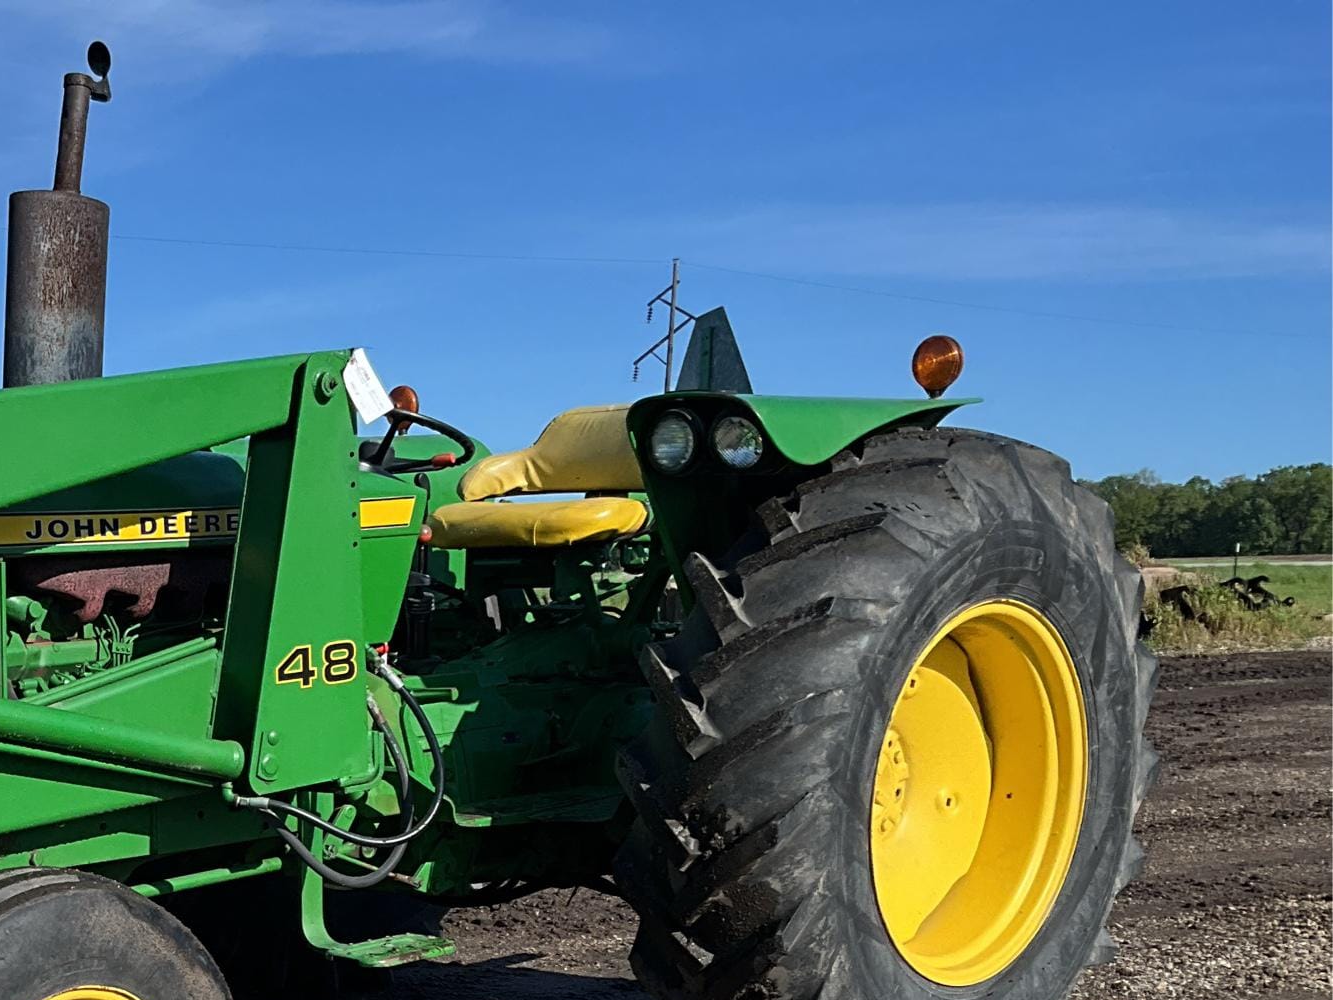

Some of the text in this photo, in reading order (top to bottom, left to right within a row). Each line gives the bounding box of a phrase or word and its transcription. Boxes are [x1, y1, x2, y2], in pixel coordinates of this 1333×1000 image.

[26, 513, 239, 539] JOHN DEERE
[276, 640, 357, 688] 48
